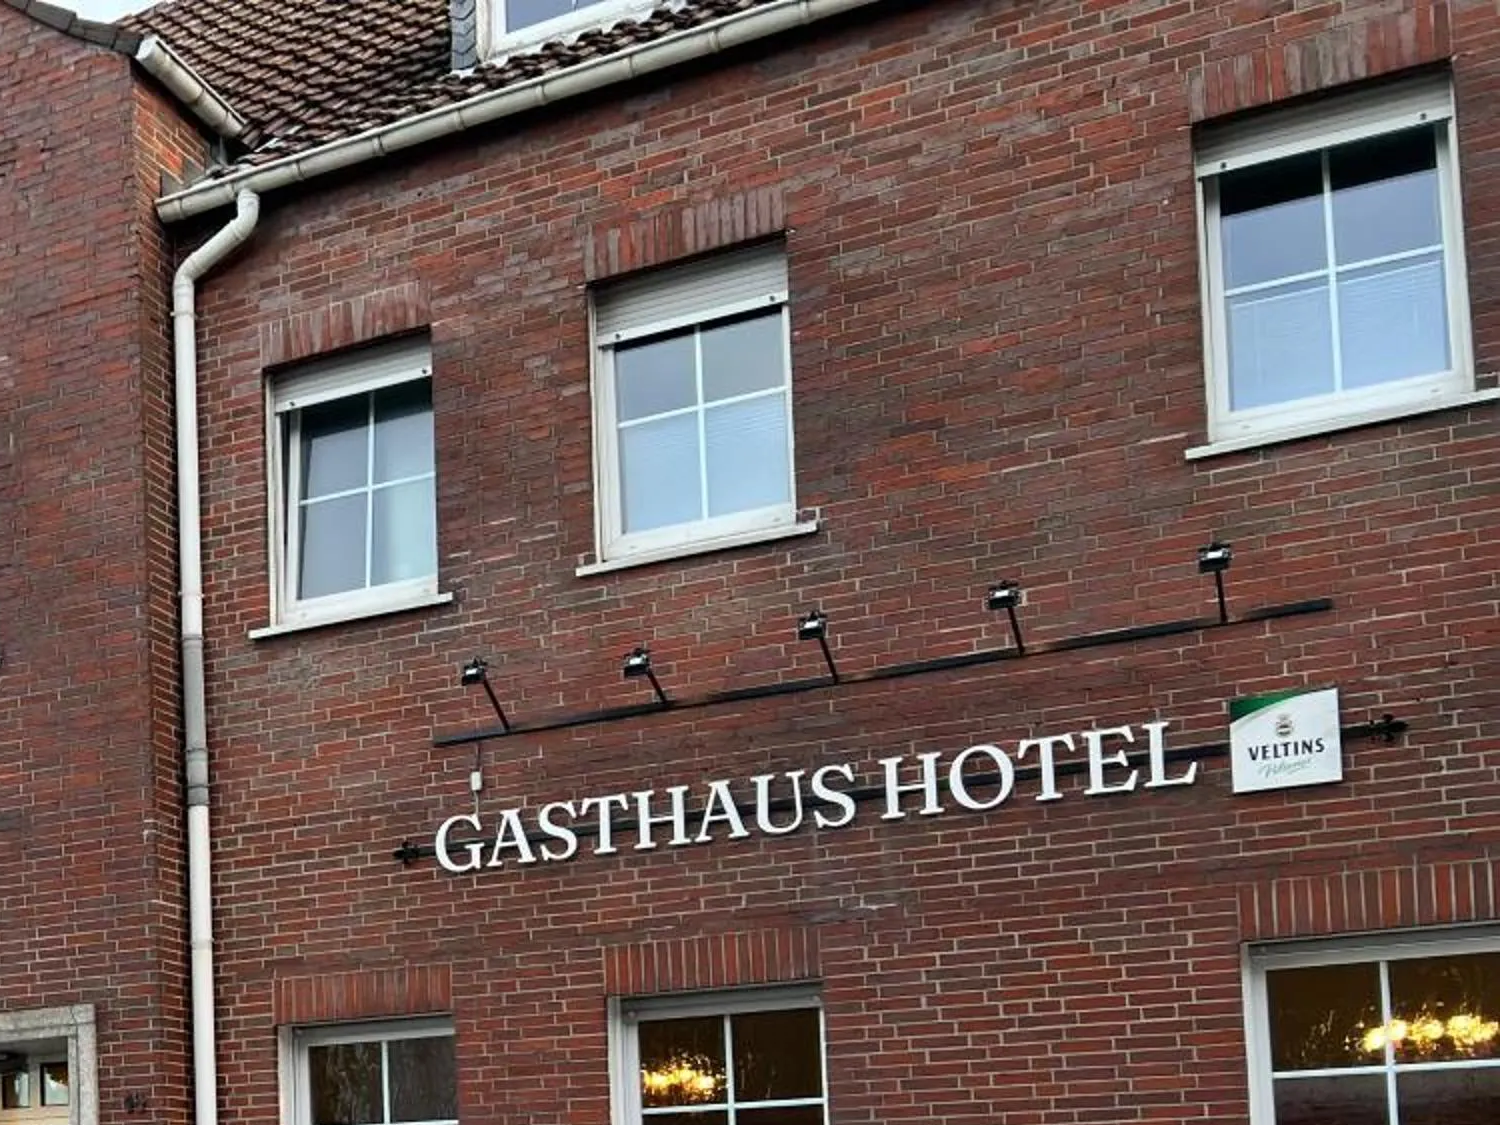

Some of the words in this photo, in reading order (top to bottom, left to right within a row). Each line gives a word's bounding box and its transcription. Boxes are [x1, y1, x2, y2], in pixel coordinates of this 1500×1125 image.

[1248, 737, 1325, 761] VELTINS
[435, 764, 856, 873] GASTHAUS
[878, 721, 1198, 820] HOTEL
